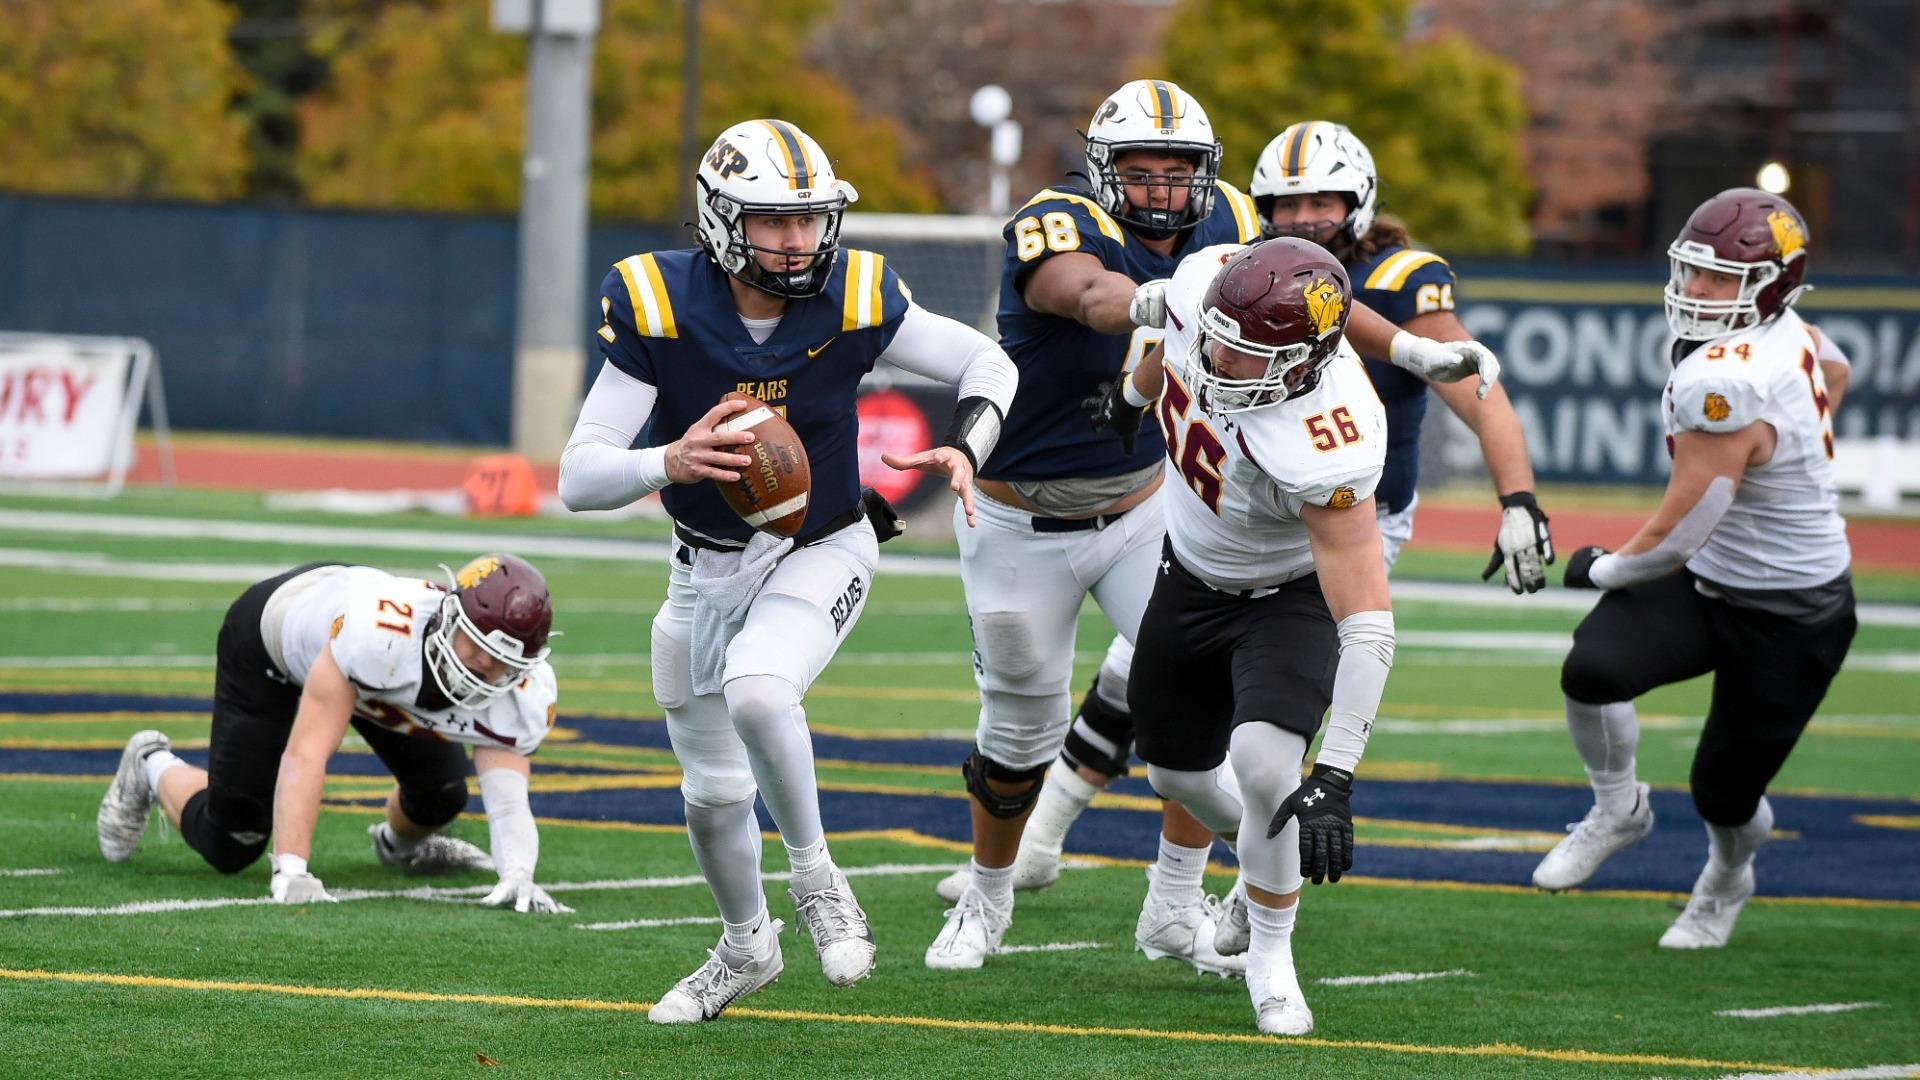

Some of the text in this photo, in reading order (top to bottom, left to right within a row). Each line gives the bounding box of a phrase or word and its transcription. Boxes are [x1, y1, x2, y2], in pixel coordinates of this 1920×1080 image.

[798, 191, 812, 199] CSP
[1014, 211, 1081, 262] 68
[1213, 313, 1231, 329] DOGS
[1706, 343, 1752, 361] 54
[1162, 361, 1227, 518] 56
[1302, 405, 1363, 454] 56
[754, 441, 779, 494] Wilson
[375, 598, 414, 638] 21
[830, 576, 862, 637] BEARS
